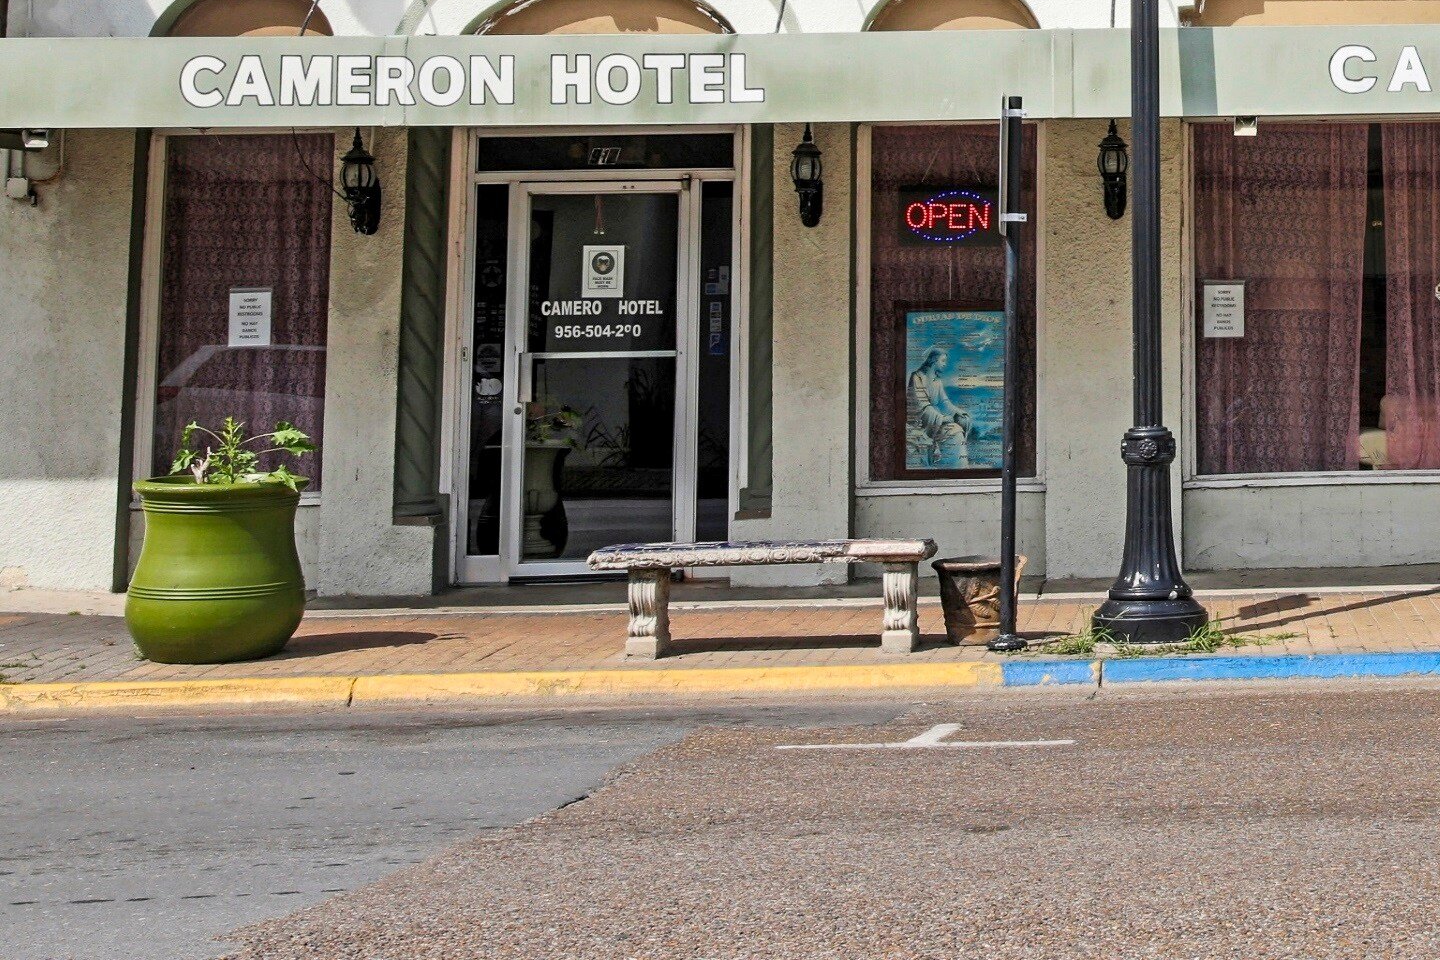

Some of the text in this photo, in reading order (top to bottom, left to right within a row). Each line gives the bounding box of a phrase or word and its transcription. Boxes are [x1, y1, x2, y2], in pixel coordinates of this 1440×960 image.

[179, 53, 766, 108] CAMERON HOTEL
[906, 202, 989, 230] OPEN
[541, 300, 663, 316] CAMERO HOTEL
